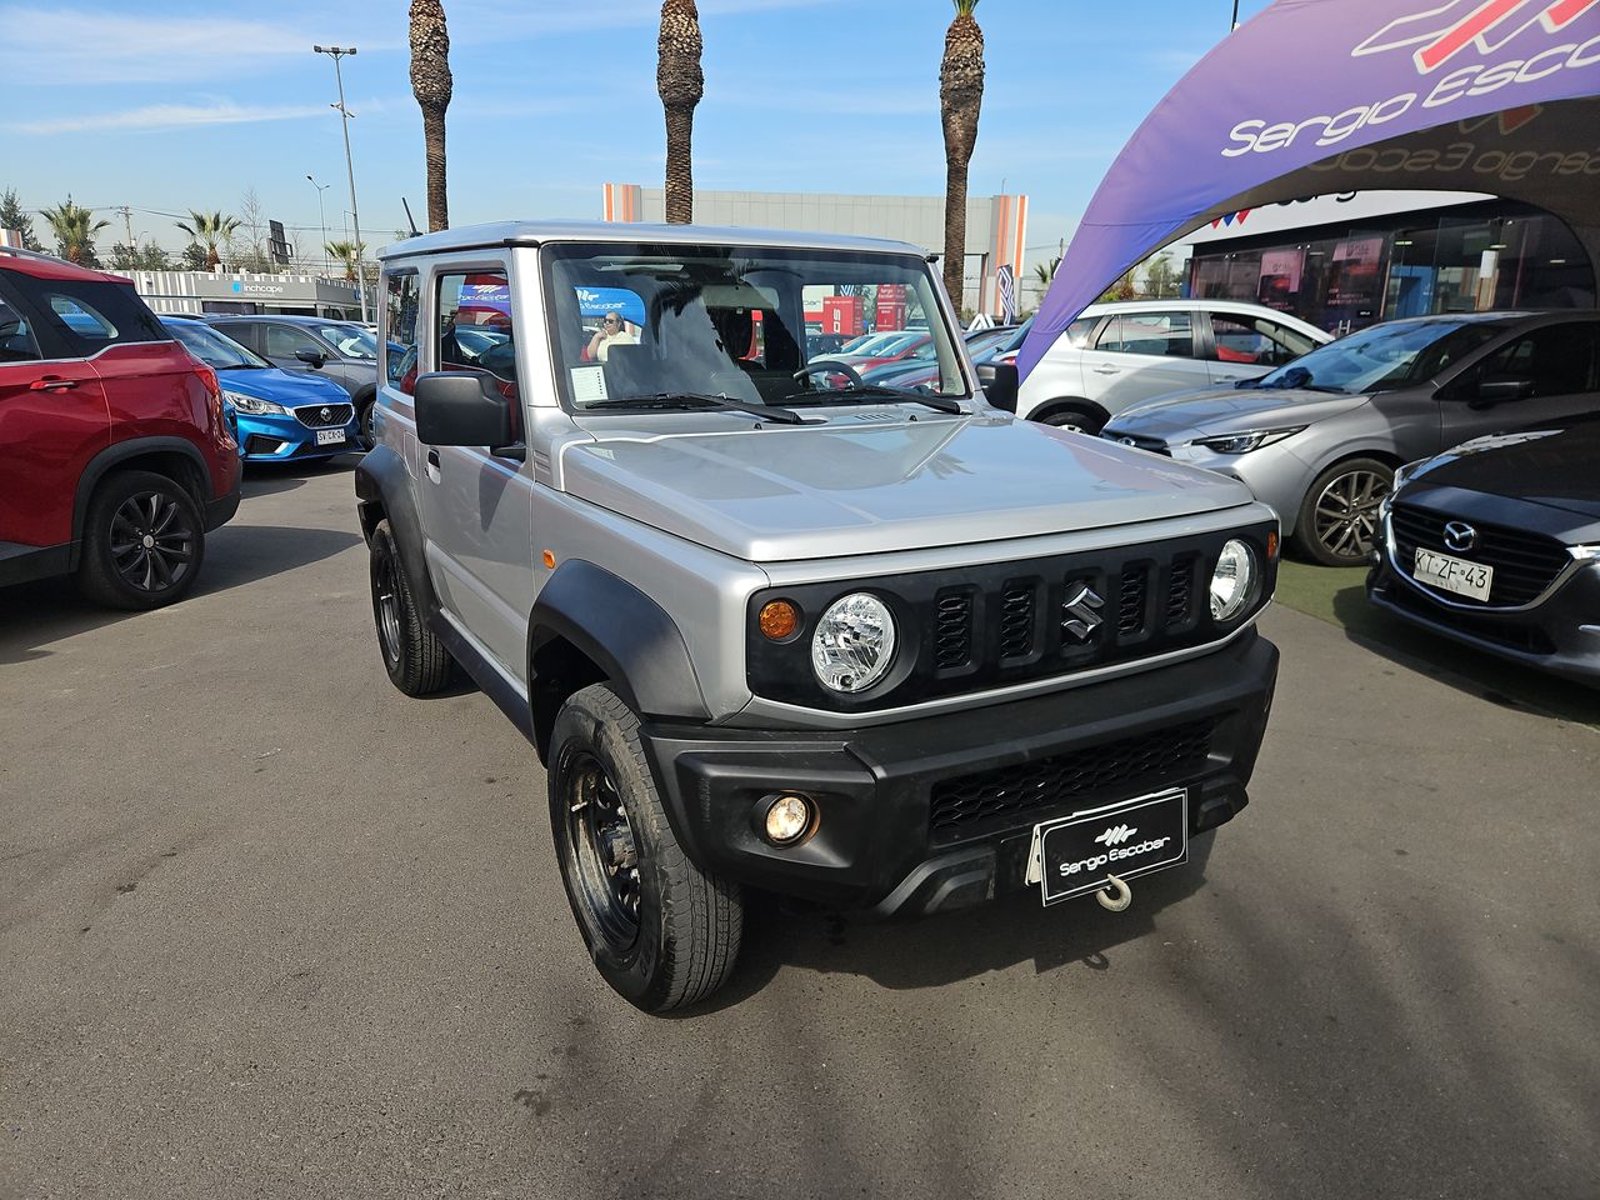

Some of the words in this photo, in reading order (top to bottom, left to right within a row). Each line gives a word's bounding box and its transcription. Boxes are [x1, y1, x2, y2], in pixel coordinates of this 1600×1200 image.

[1221, 92, 1417, 157] Sergio
[243, 283, 284, 294] inchcape
[1108, 836, 1171, 862] Escobar
